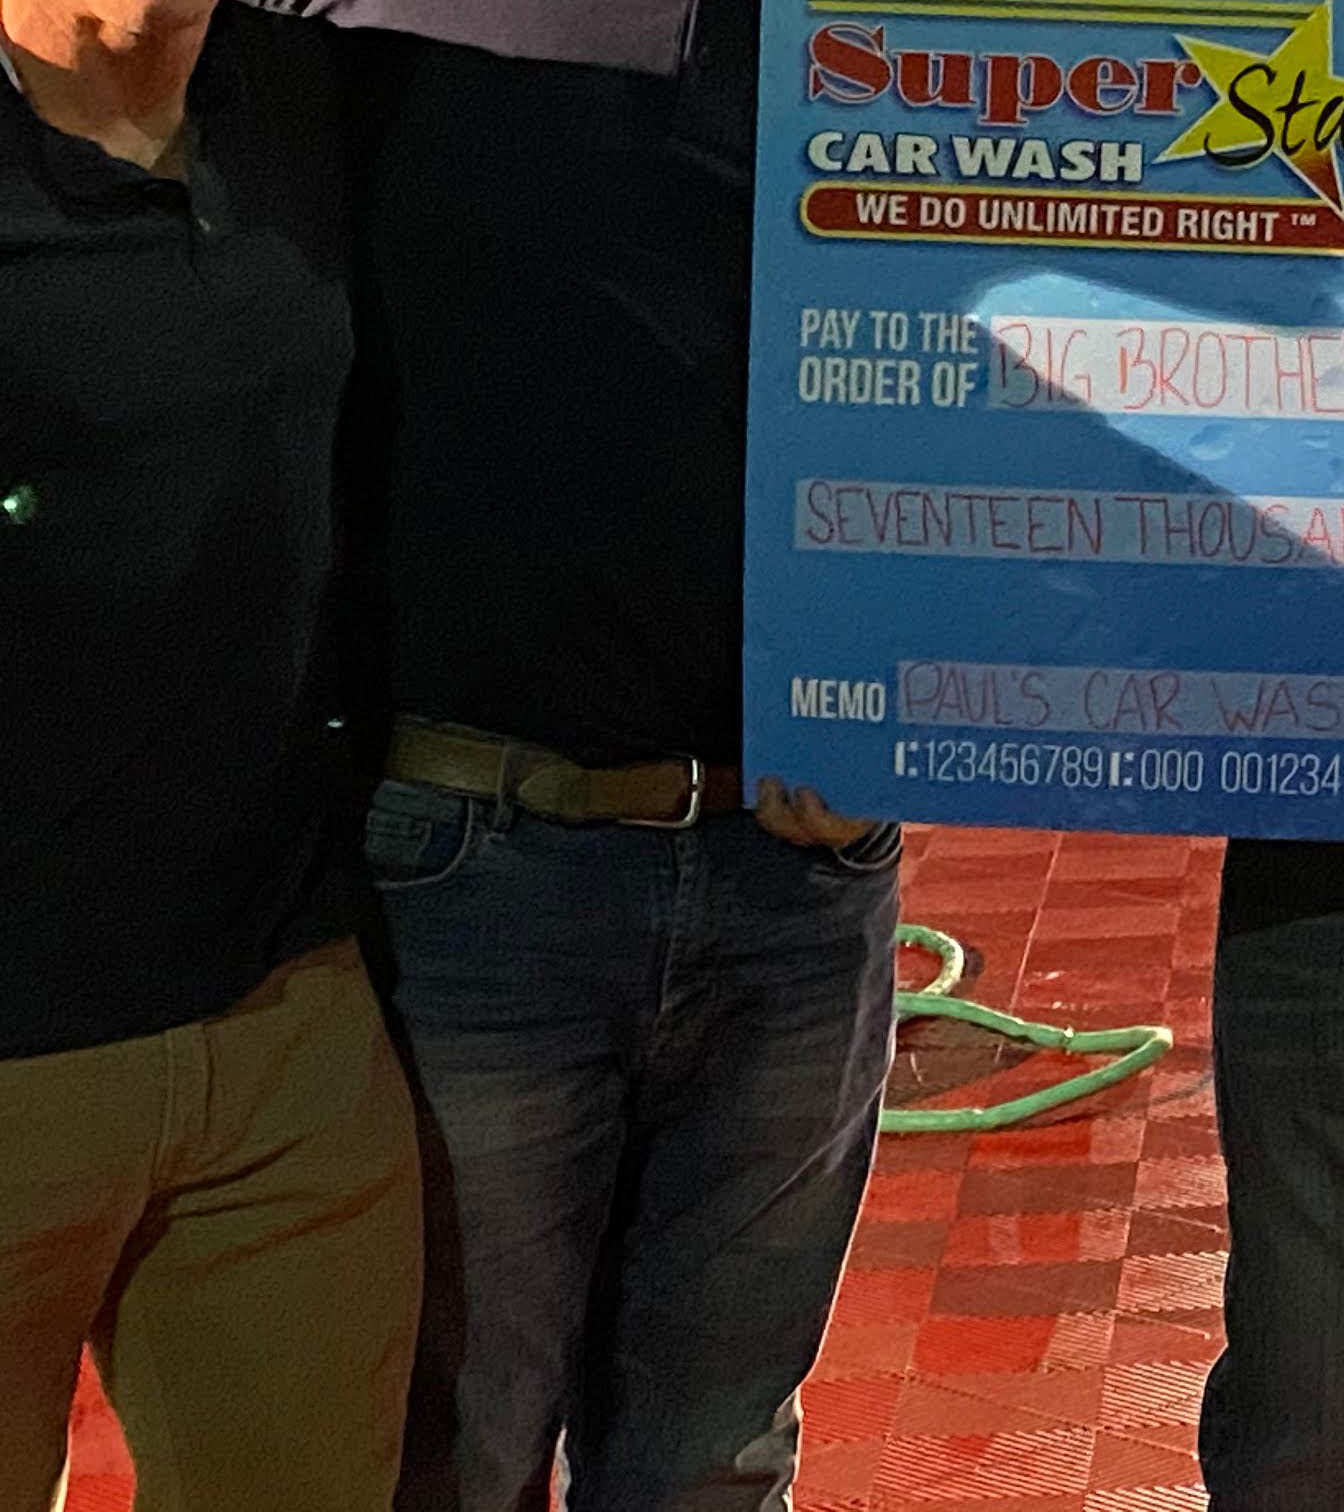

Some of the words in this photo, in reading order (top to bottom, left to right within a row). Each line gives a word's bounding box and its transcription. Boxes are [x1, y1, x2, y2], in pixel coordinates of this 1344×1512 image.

[809, 21, 1202, 126] Super
[808, 131, 938, 175] CAR
[950, 135, 1144, 183] WASH
[856, 192, 907, 226] WE
[920, 195, 967, 230] DO
[979, 197, 1167, 237] UNLIMITED
[1177, 208, 1280, 242] RIGHT
[800, 308, 866, 350] PAY
[870, 310, 914, 352] TO
[920, 312, 978, 355] THE
[799, 356, 922, 406] ORDER
[931, 361, 977, 409] OF
[998, 323, 1093, 409] BIG
[806, 481, 1100, 556] SEVENTEEN
[790, 677, 886, 723] MEMO
[903, 662, 1050, 727] PAUL'S
[1083, 671, 1185, 732] CAR
[1221, 751, 1341, 797] 001234
